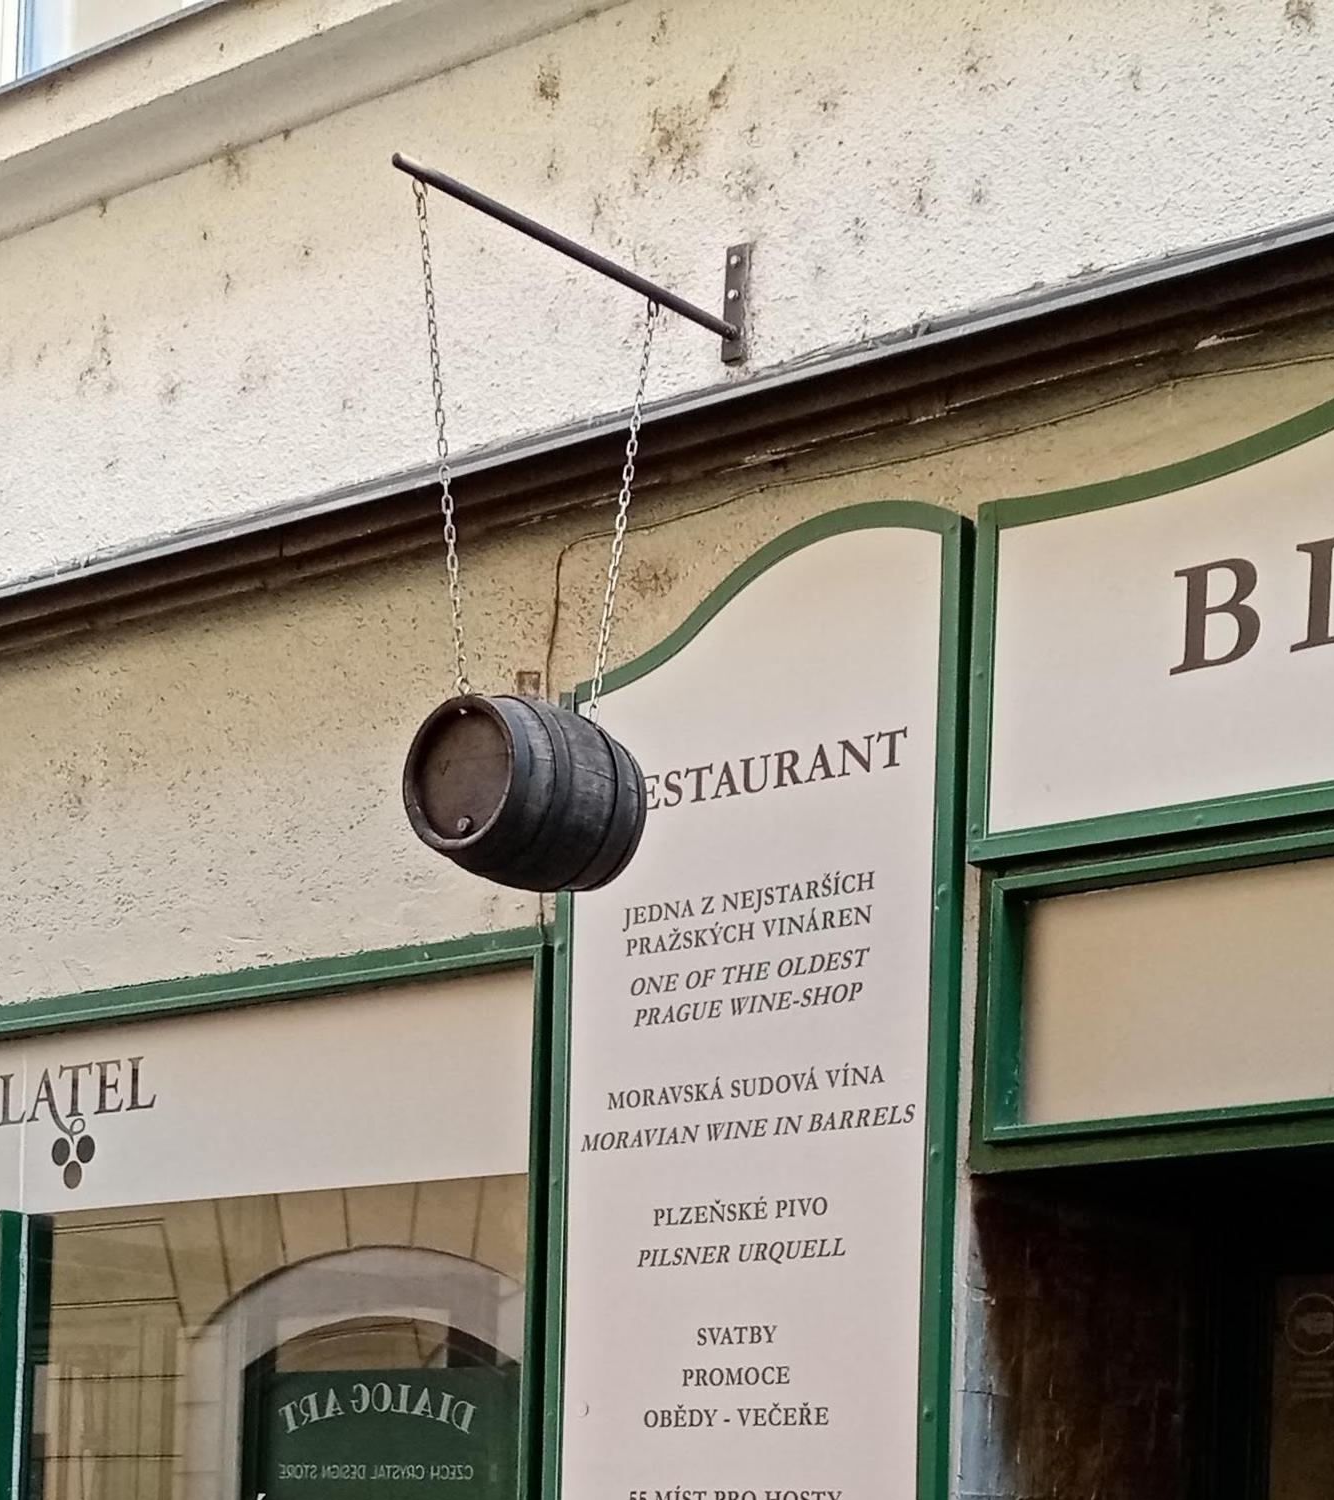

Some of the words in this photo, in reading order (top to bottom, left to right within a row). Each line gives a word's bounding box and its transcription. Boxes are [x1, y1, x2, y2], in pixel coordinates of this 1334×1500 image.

[646, 727, 908, 812] ESTAURANT
[624, 899, 694, 932] JEDNA
[702, 898, 714, 914] Z
[722, 870, 876, 913] NEJSTARŠÍCH
[626, 922, 755, 958] PRAŽSKÝCH
[764, 904, 872, 939] VINÁREN
[630, 970, 678, 997] ONE
[686, 969, 716, 991] OF
[723, 962, 769, 988] THE
[778, 947, 870, 978] OLDEST
[634, 999, 722, 1028] PRAGUE
[730, 981, 863, 1017] WINE-SHOP
[607, 1075, 723, 1110] MORAVSKÁ
[731, 1067, 816, 1099] SUDOVÁ
[826, 1064, 885, 1090] VÍNA
[581, 1125, 698, 1153] MORAVIAN
[706, 1118, 766, 1140] WINE
[775, 1115, 801, 1136] IN
[809, 1103, 915, 1133] BARRELS
[653, 1196, 769, 1227] PLZEŇSKÉ
[776, 1196, 828, 1218] PIVO
[638, 1245, 730, 1267] PILSNER
[738, 1238, 846, 1264] URQUELL
[697, 1325, 777, 1346] SVATBY
[682, 1366, 790, 1387] PROMOCE
[644, 1404, 719, 1428] OBĚDY
[737, 1403, 829, 1427] VEČEŘE
